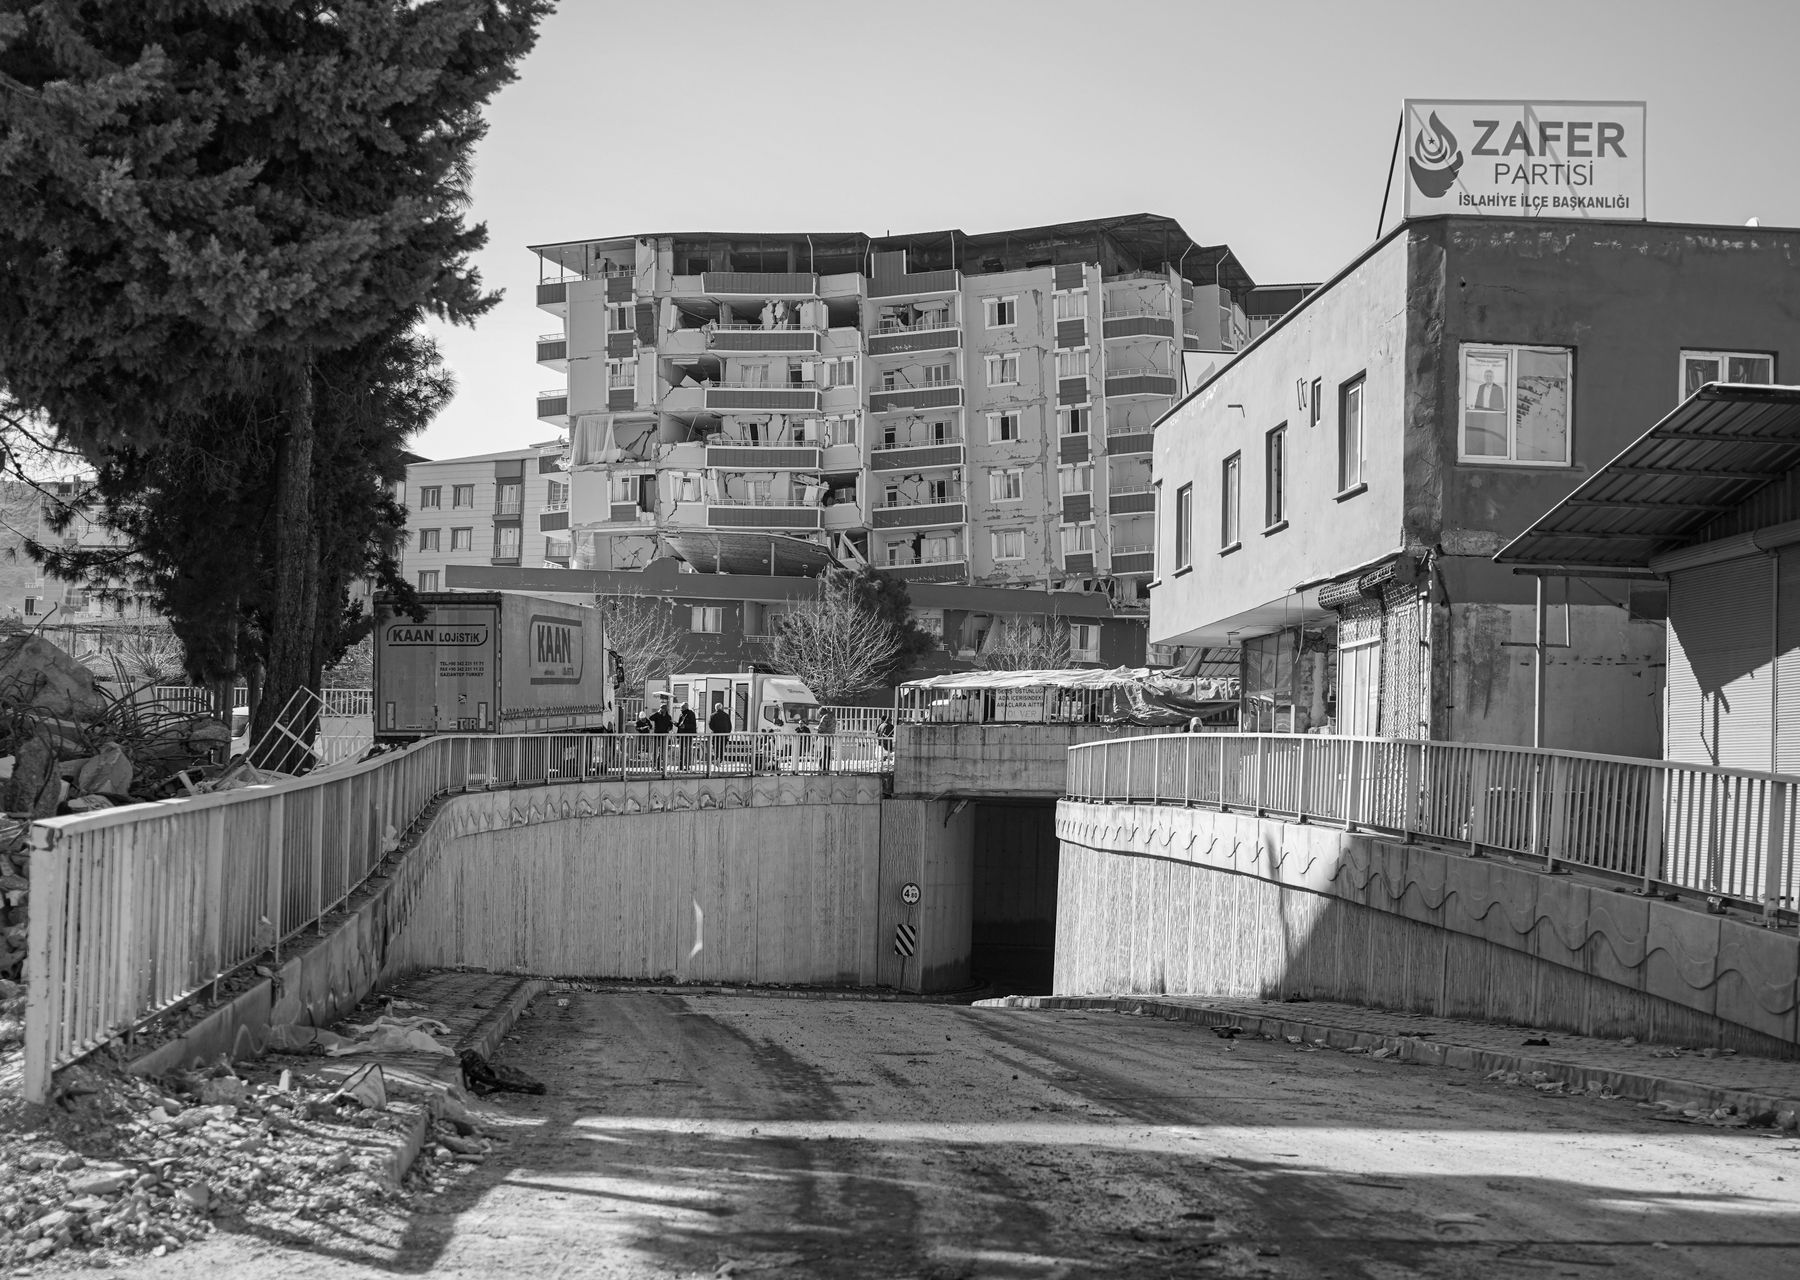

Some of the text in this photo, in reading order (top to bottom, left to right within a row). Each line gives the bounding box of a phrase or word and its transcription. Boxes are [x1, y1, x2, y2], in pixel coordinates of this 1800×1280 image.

[1471, 120, 1627, 158] ZAFER
[1494, 160, 1593, 186] PARTİSİ
[1459, 192, 1630, 211] İSLAHİYE İLÇE BAŞKANLIĞI
[393, 629, 434, 642] KAAN
[537, 625, 571, 663] KAAN
[904, 889, 910, 898] 4
